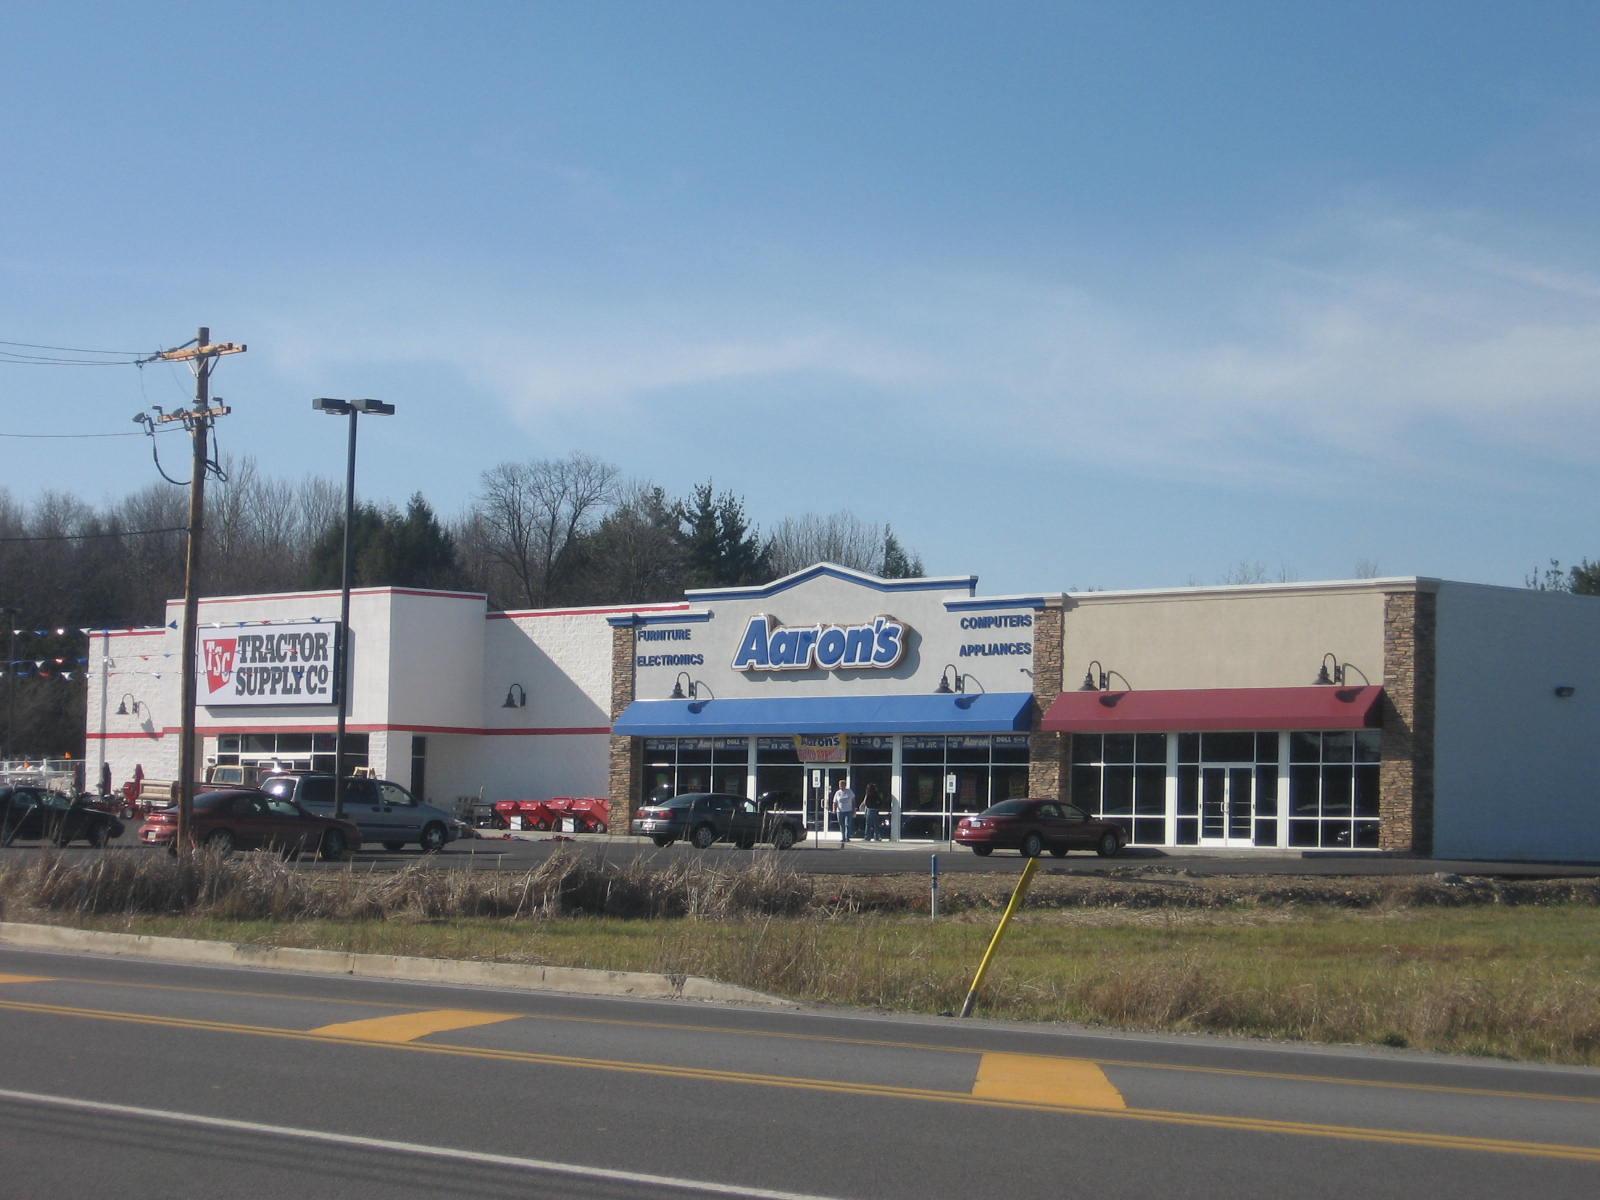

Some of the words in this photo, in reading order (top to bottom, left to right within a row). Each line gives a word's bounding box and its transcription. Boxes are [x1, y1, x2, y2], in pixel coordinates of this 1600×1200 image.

[961, 615, 1032, 629] COMPUTERS
[637, 628, 692, 642] FURNITURE
[731, 615, 903, 669] Aaron's
[238, 632, 328, 663] TRACTOR
[959, 642, 1032, 657] APPLIANCES
[206, 640, 231, 682] TSC
[637, 654, 704, 667] ELECTRONICS
[235, 665, 305, 696] SUPPLY
